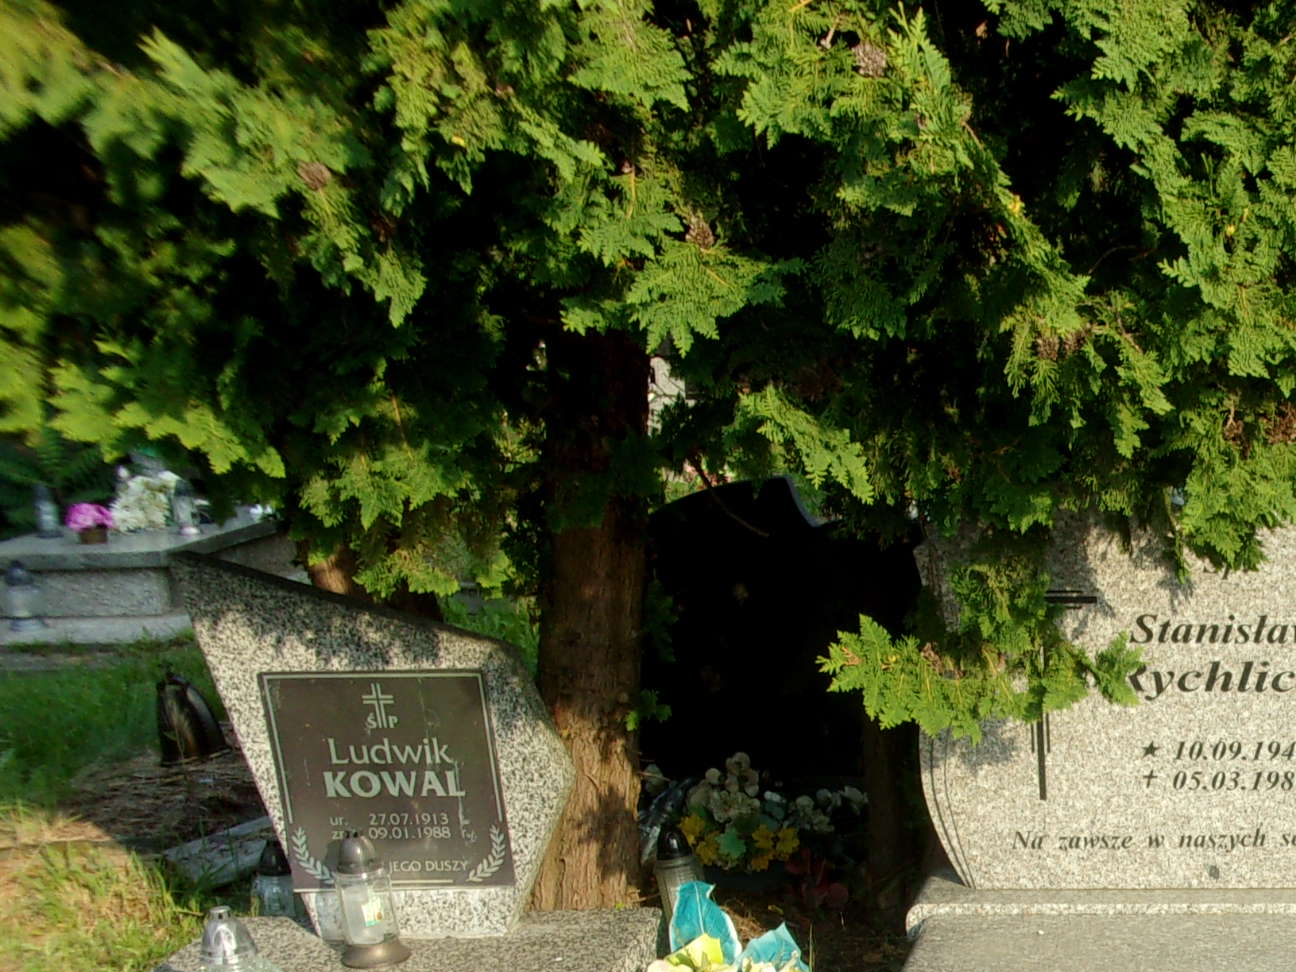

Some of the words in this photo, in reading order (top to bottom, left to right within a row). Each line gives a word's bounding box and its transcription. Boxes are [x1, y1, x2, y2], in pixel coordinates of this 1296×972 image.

[327, 736, 453, 765] Ludwik
[323, 770, 466, 798] KOWAL
[329, 815, 349, 826] ur.
[368, 812, 449, 826] 27.07.1913
[368, 826, 451, 840] 09.01.1988
[1011, 829, 1045, 850] Na
[1058, 835, 1133, 851] zawsze
[1147, 835, 1166, 849] w
[1179, 826, 1267, 851] naszych
[388, 860, 421, 874] JEGO
[425, 859, 470, 872] DUSZY
